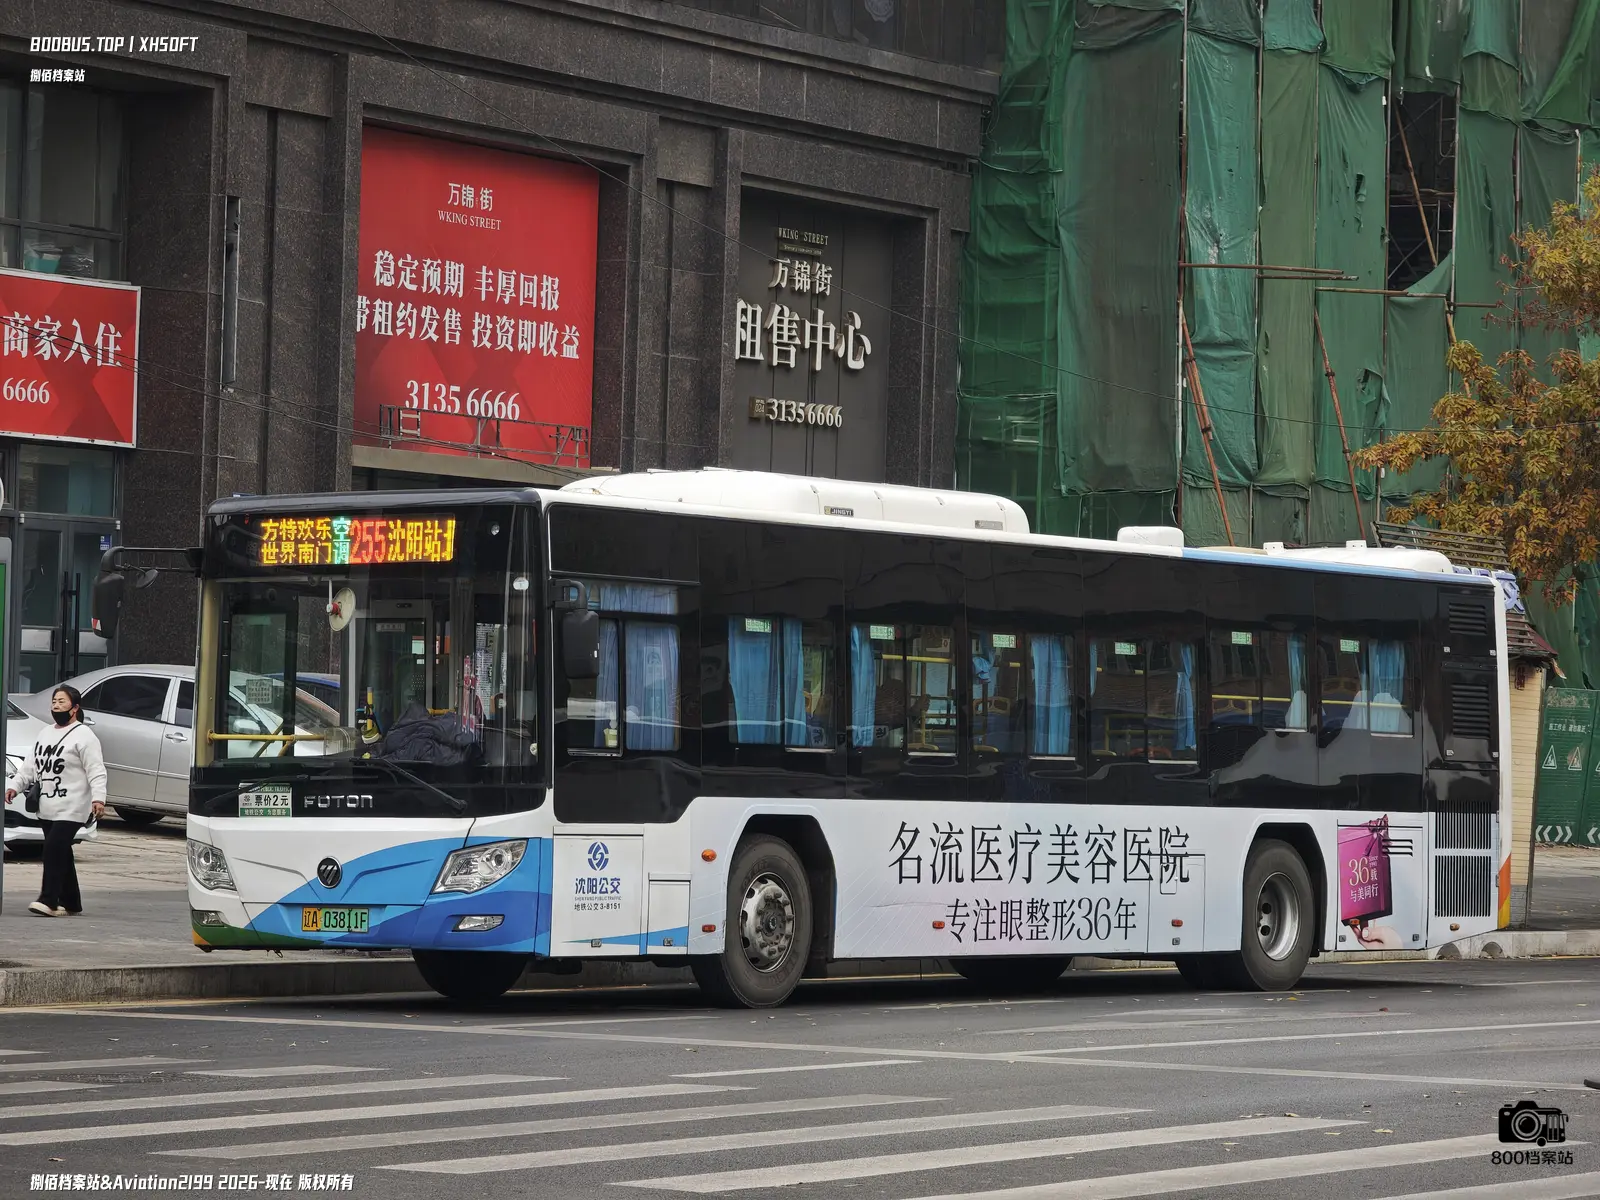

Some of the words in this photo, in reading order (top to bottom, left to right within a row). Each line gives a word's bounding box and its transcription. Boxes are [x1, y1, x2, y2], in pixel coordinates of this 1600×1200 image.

[447, 182, 493, 212] 万锦街
[438, 210, 468, 226] WKING
[469, 215, 502, 231] STREET
[803, 231, 829, 246] STREET
[373, 250, 465, 298] 稳定预期
[474, 265, 560, 311] 丰厚回报
[768, 258, 833, 296] 万锦街
[3, 311, 123, 367] 商家入住
[356, 296, 463, 345] 带租约发售
[471, 311, 580, 359] 投资即收益
[735, 299, 872, 371] 租售中心
[3, 377, 50, 404] 6666
[261, 518, 332, 541] 方特欢乐
[350, 520, 387, 564] 255
[261, 541, 332, 564] 世界南门
[254, 794, 289, 806] 票价2元
[304, 795, 373, 808] FOTON
[888, 821, 1190, 885] 名流医疗美容医院
[575, 877, 621, 894] 沈阳公交
[1350, 883, 1378, 903] 与美同行
[945, 897, 1137, 943] 专注眼整形36年
